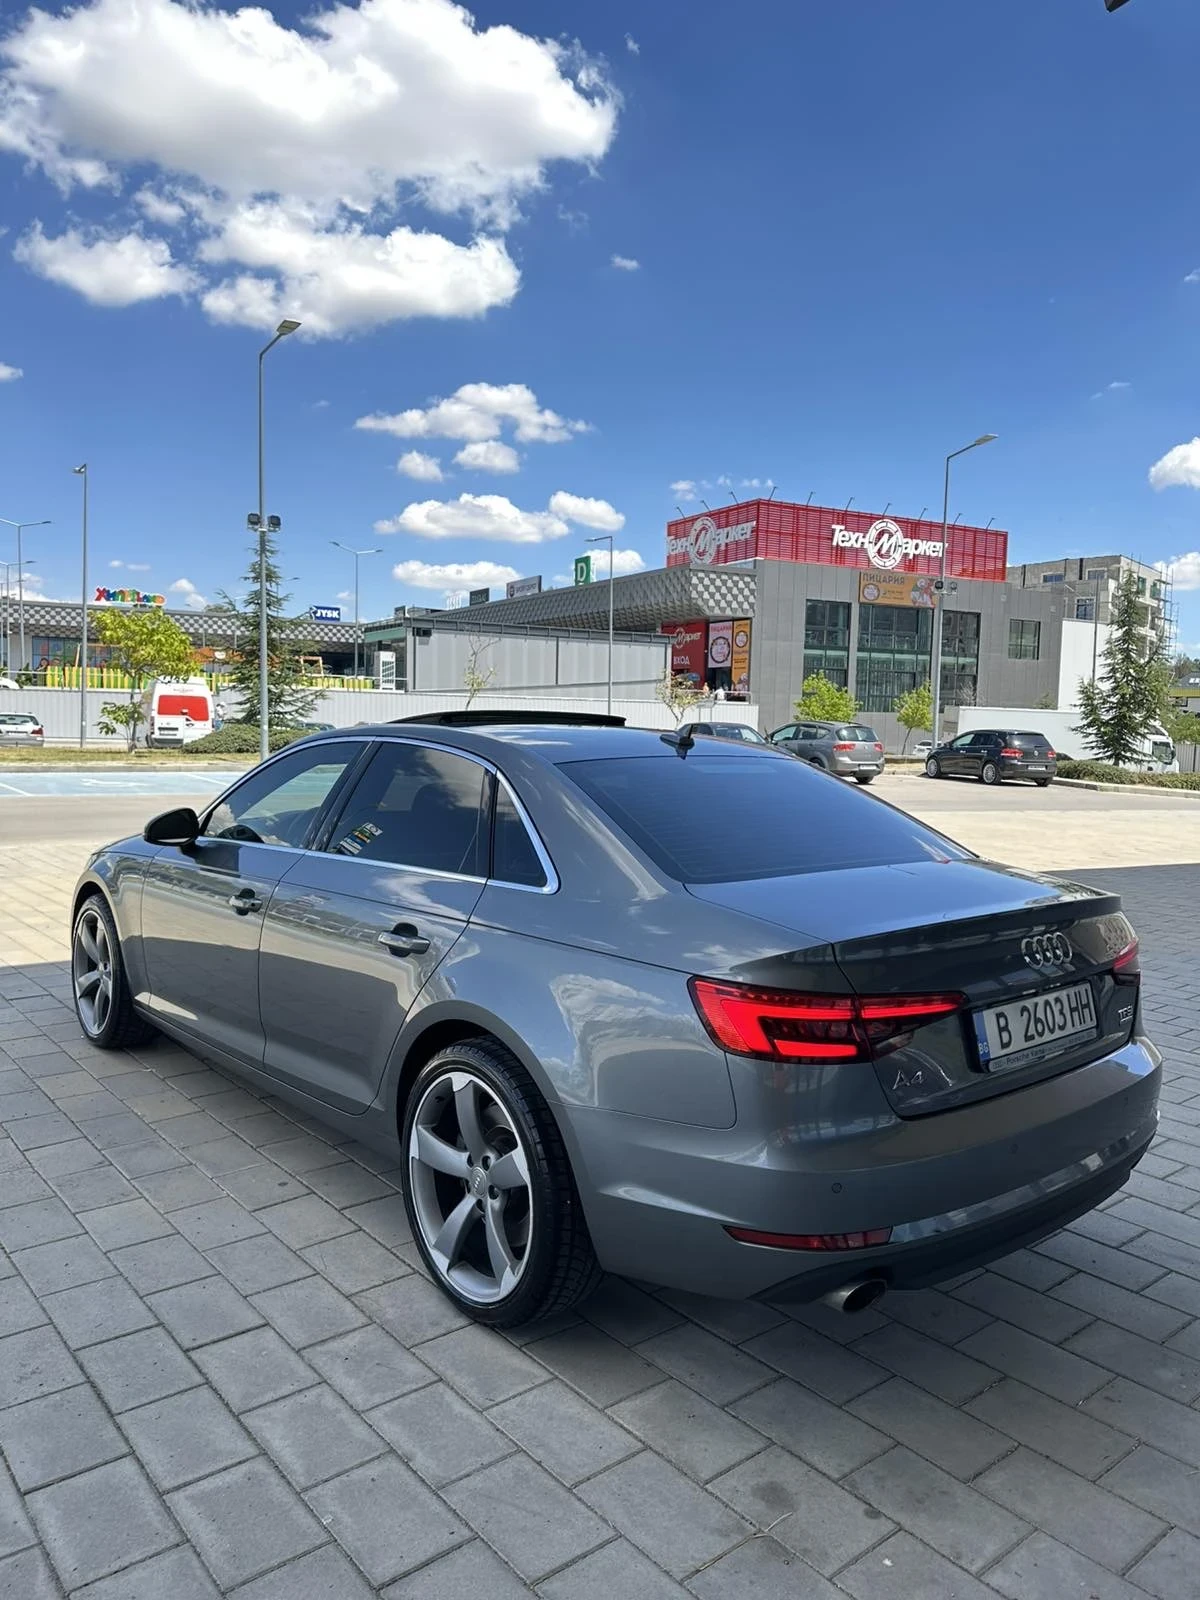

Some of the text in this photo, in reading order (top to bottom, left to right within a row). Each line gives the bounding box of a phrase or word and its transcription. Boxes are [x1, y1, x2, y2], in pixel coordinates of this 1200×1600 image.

[863, 572, 905, 585] ПИЦАРИЯ
[316, 609, 340, 618] JYSK
[995, 1011, 1013, 1050] B
[1020, 996, 1068, 1043] 2603
[1066, 988, 1093, 1028] HH
[978, 1042, 989, 1054] BG
[892, 1070, 924, 1090] A4
